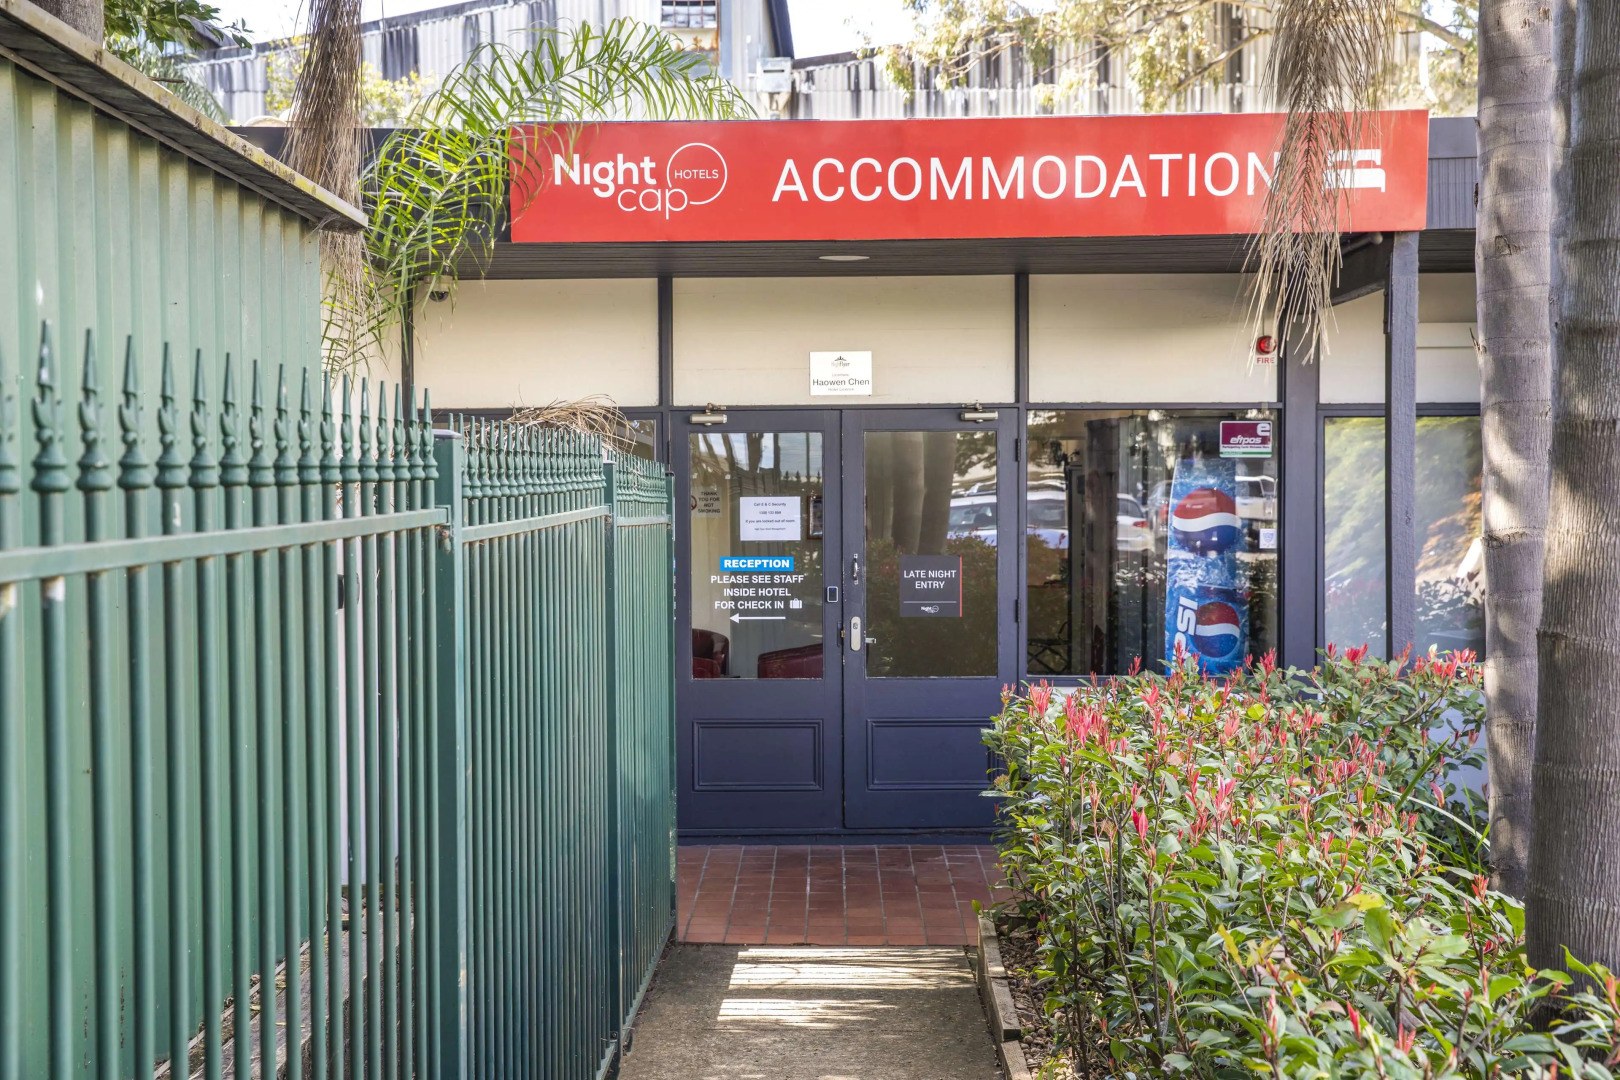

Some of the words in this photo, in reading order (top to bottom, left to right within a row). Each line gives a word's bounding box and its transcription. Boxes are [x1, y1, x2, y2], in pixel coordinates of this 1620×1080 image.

[554, 153, 657, 198] Night
[674, 169, 719, 179] HOTELS
[771, 151, 1281, 202] ACCOMMODATION
[617, 187, 688, 220] cap
[812, 378, 846, 386] Haowen
[848, 378, 870, 386] Chen
[1230, 435, 1262, 445] eftpos
[723, 559, 790, 568] RECEPTION
[903, 570, 926, 578] LATE
[928, 570, 957, 578] NIGHT
[710, 575, 749, 584] PLEASE
[751, 575, 772, 583] SEE
[773, 575, 804, 583] STAFF
[915, 581, 945, 589] ENTRY
[723, 588, 756, 596] INSIDE
[758, 588, 791, 596] HOTEL
[714, 601, 735, 610] FOR
[737, 600, 772, 609] CHECK
[774, 600, 784, 609] IN
